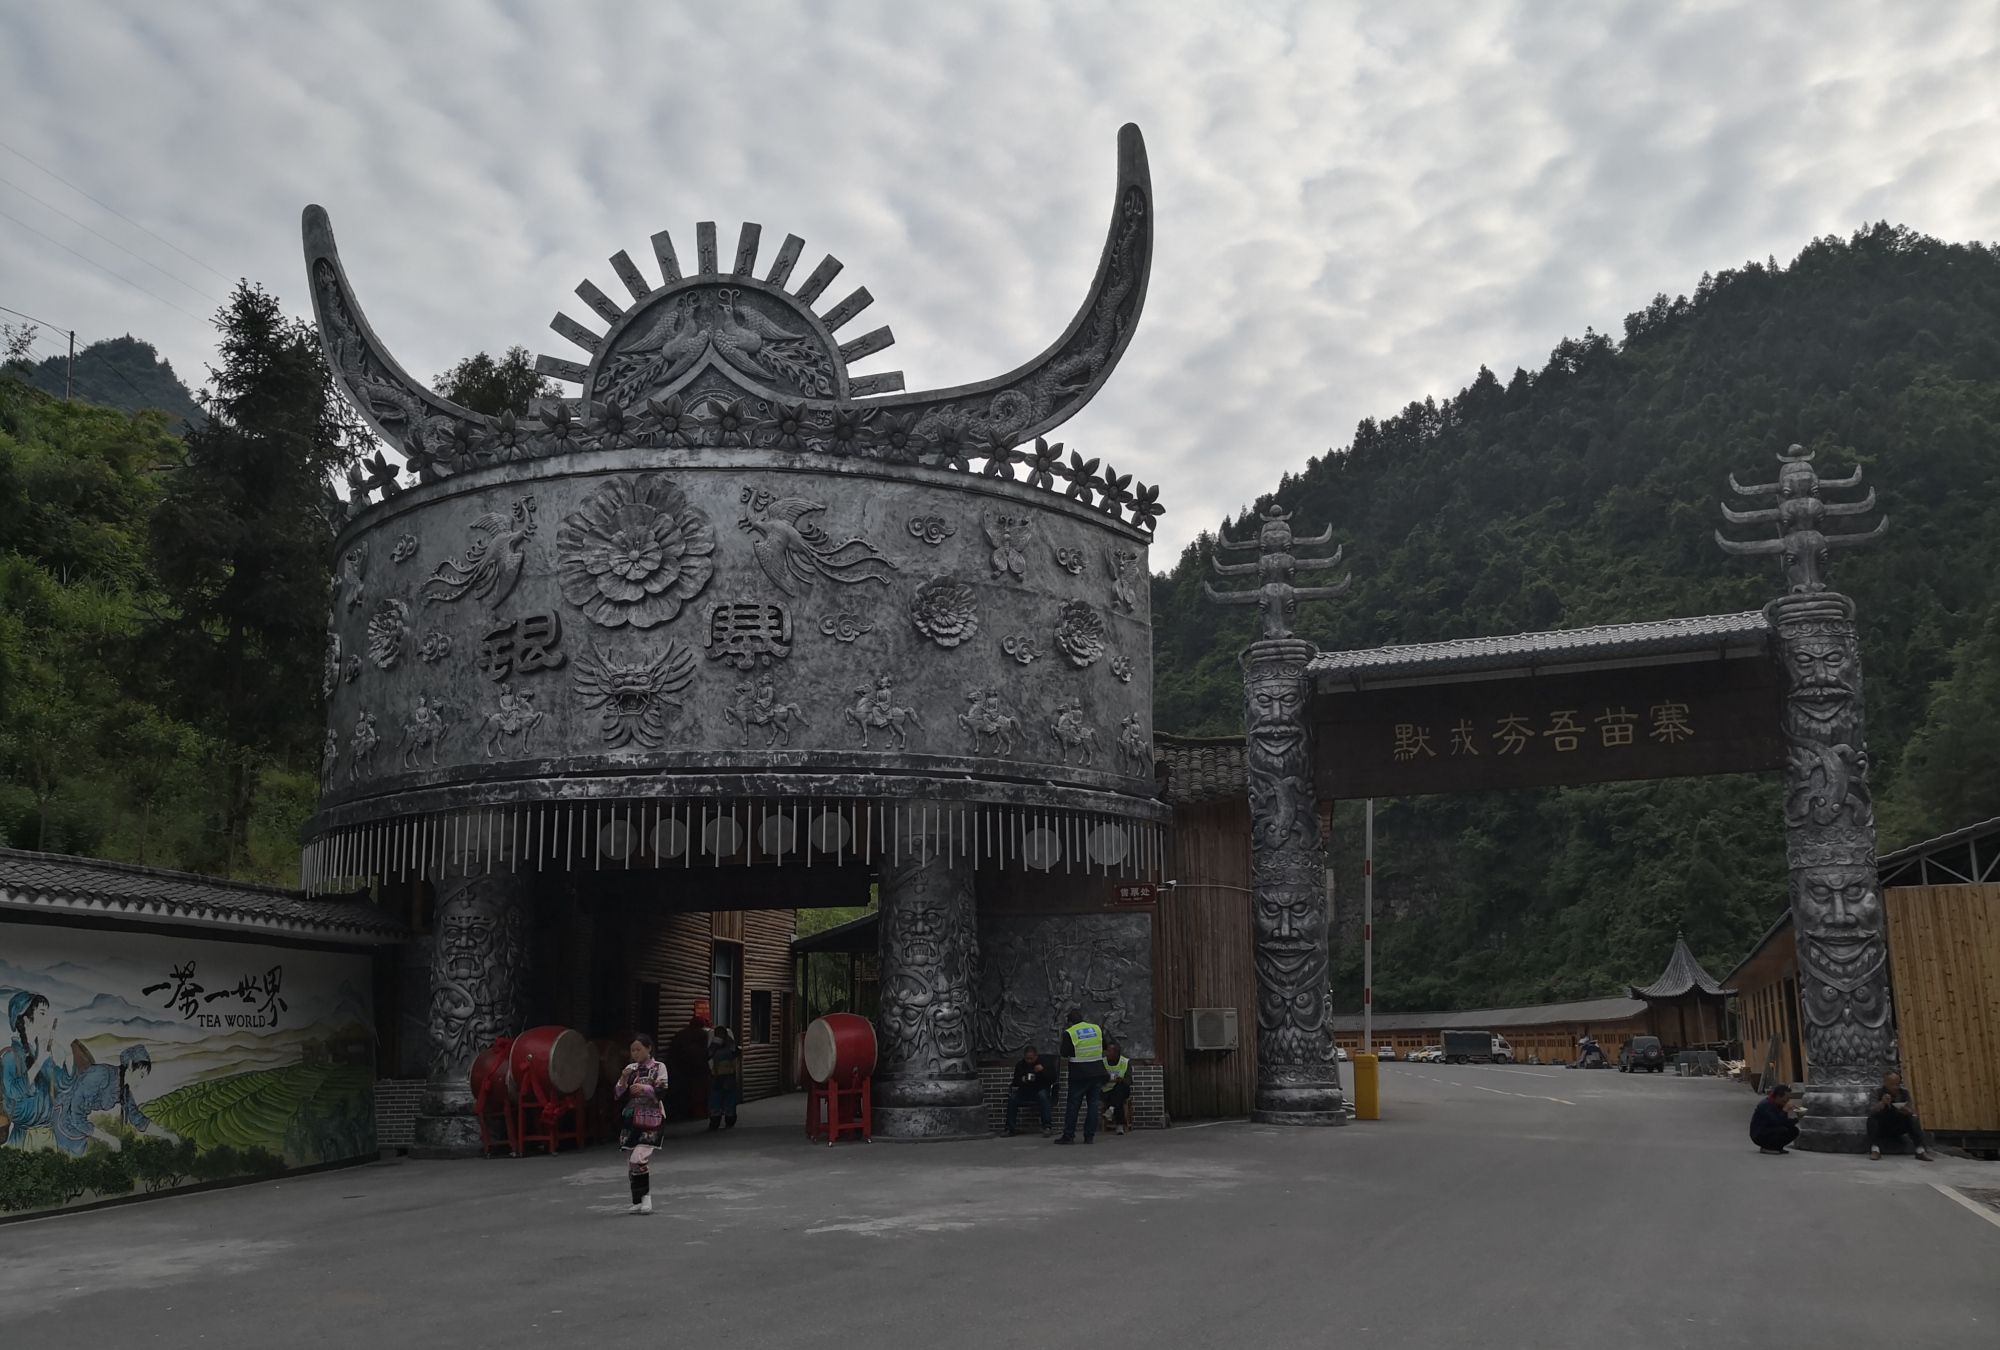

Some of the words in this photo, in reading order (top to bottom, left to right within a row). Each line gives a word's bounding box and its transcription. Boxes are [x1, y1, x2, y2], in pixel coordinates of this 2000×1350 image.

[1392, 699, 1696, 762] 默戎夯吾苗寨
[1120, 887, 1151, 897] 售票处
[142, 960, 288, 1027] 一茶一世界
[198, 1014, 221, 1027] TEA
[224, 1014, 266, 1028] WORLD
